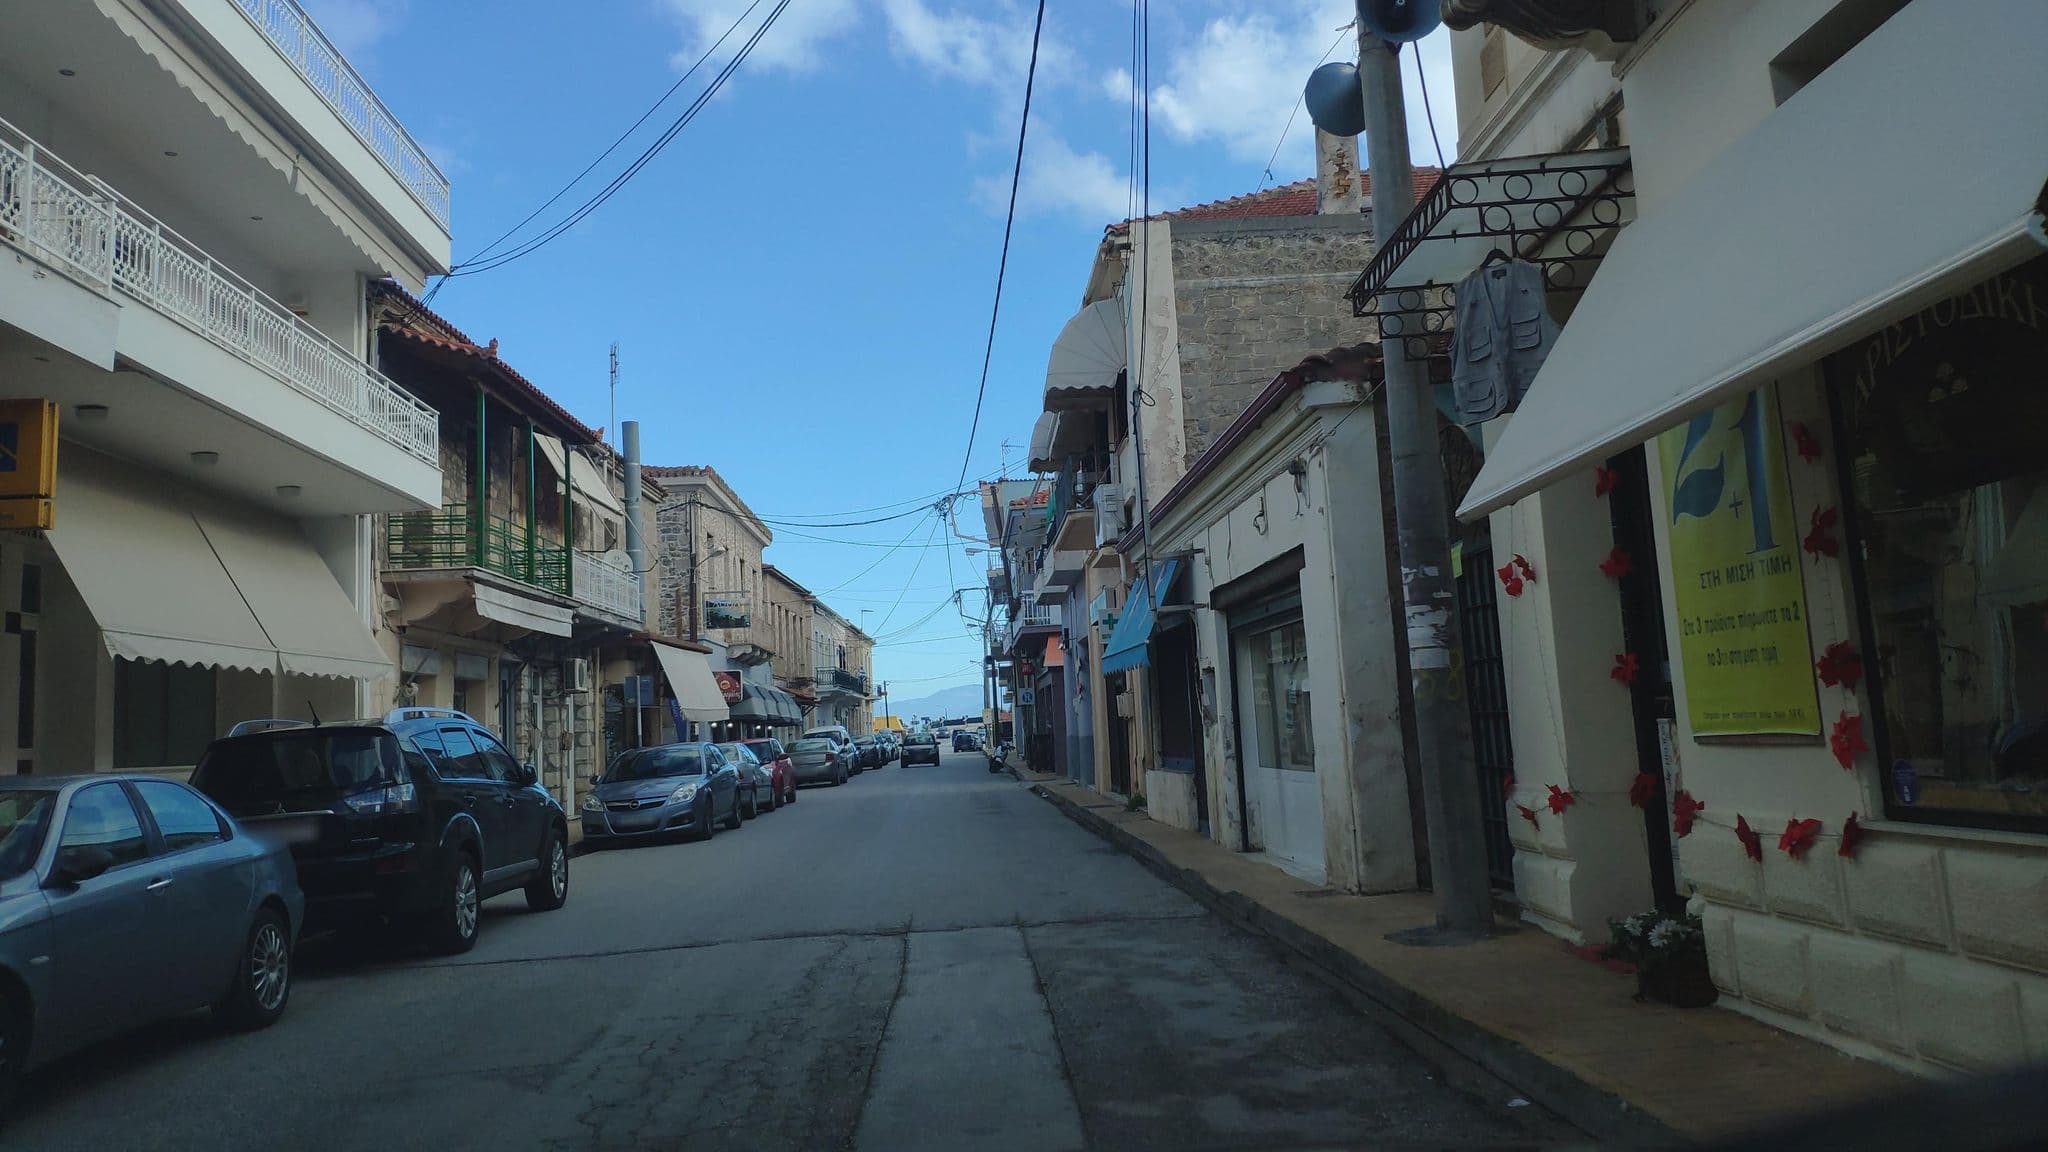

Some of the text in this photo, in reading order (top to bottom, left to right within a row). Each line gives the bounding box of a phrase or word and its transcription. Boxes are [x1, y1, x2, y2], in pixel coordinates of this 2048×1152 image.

[1699, 554, 1792, 590] ΣΤΗ ΜΙΣΗ ΤΙΜΗ
[1696, 615, 1702, 634] 3
[1792, 600, 1801, 620] 2
